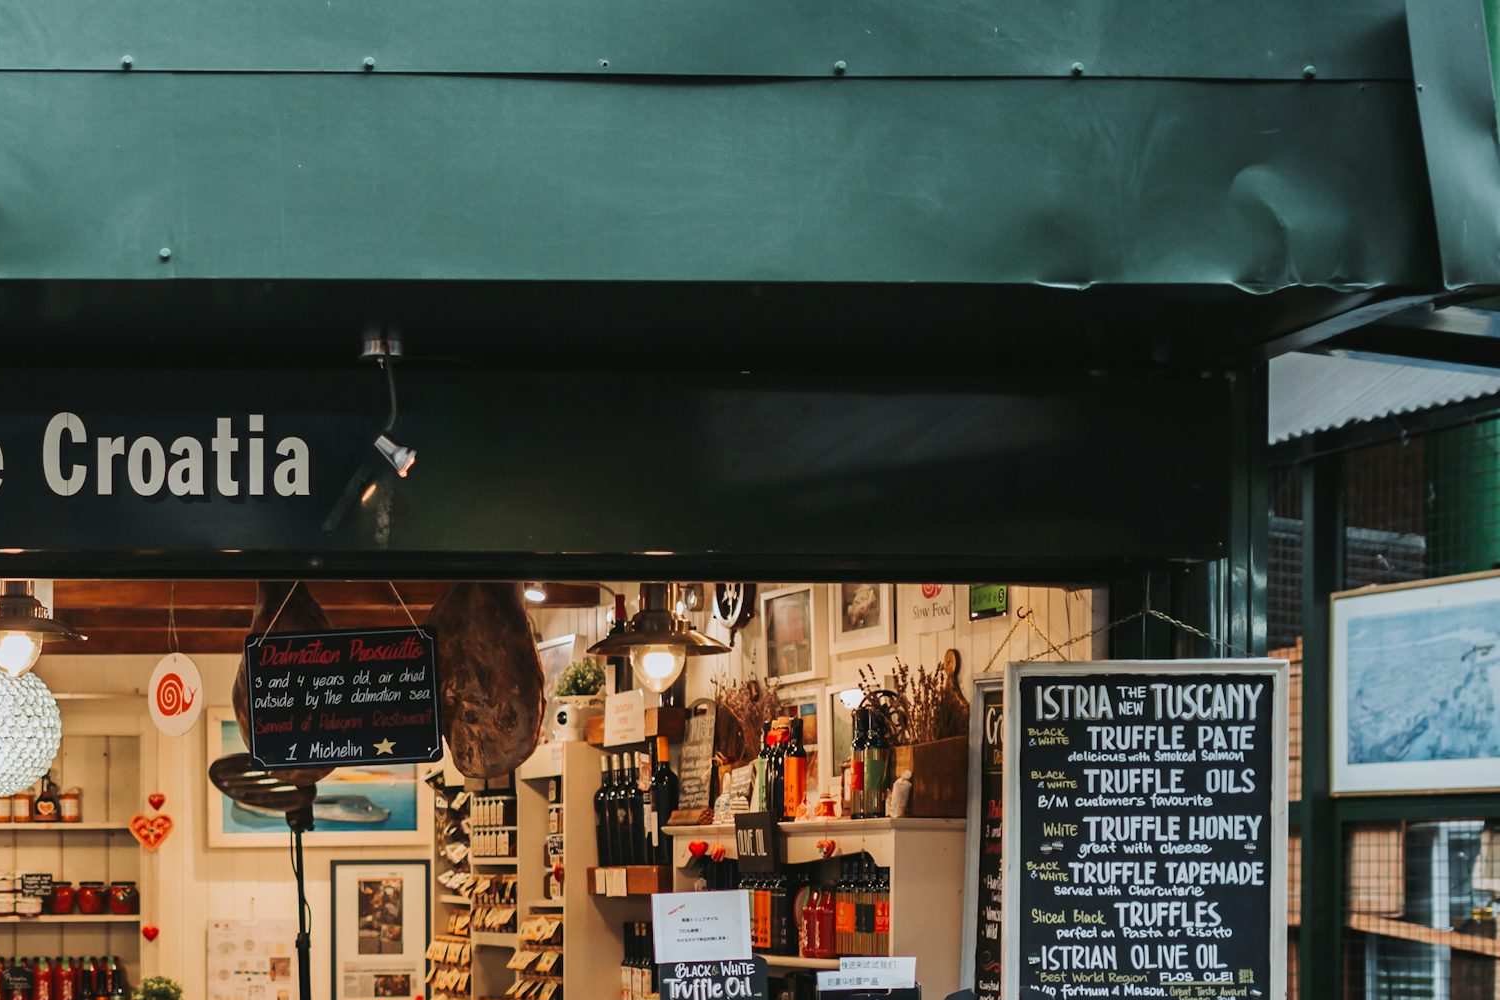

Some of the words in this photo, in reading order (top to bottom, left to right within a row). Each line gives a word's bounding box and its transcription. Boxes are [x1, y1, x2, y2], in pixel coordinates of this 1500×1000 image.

[41, 412, 311, 497] Croatia
[913, 605, 928, 619] Slow
[932, 601, 951, 617] Food
[255, 678, 263, 688] 3
[268, 672, 290, 688] and
[297, 675, 305, 686] 4
[313, 674, 345, 690] years
[378, 672, 394, 683] air
[399, 665, 426, 682] dried
[255, 691, 295, 708] outside
[305, 691, 319, 709] by
[325, 689, 342, 705] the
[1036, 684, 1114, 721] ISTRIA
[1116, 685, 1147, 699] THE
[1151, 683, 1264, 721] TUSCANY
[1118, 700, 1144, 716] NEW
[1086, 726, 1185, 750] TRUFFLE
[1198, 726, 1256, 750] PATE
[285, 743, 298, 761] 1
[309, 740, 363, 759] Michelin
[1068, 751, 1126, 762] delicious
[1128, 752, 1150, 762] with
[1154, 750, 1196, 762] Smoked
[1202, 750, 1244, 762] Salmon
[1083, 768, 1186, 794] TRUFFLE
[1206, 768, 1256, 794] OILS
[1043, 822, 1078, 838] WHITE
[1082, 816, 1181, 842] TRUFFLE
[1188, 815, 1262, 841] HONEY
[737, 829, 755, 856] OLIVE
[755, 828, 767, 856] OIL
[1068, 862, 1158, 886] TRUFFLE
[1165, 862, 1264, 886] TAPENADE
[1031, 908, 1066, 924] Sliced
[1072, 907, 1106, 926] Black
[1114, 901, 1222, 928] TRUFFLES
[1056, 928, 1097, 939] perfect
[1101, 930, 1115, 938] on
[1122, 927, 1163, 938] Pasta
[1167, 929, 1182, 938] or
[1186, 927, 1233, 939] Risotto
[1041, 945, 1118, 970] ISTRIAN
[1131, 944, 1189, 970] OLIVE
[1195, 944, 1228, 970] OIL
[675, 963, 711, 978] BLACK
[720, 961, 755, 976] WHITE
[1159, 972, 1194, 982] FLOS
[1203, 972, 1233, 981] OLEI
[725, 977, 753, 999] Oil
